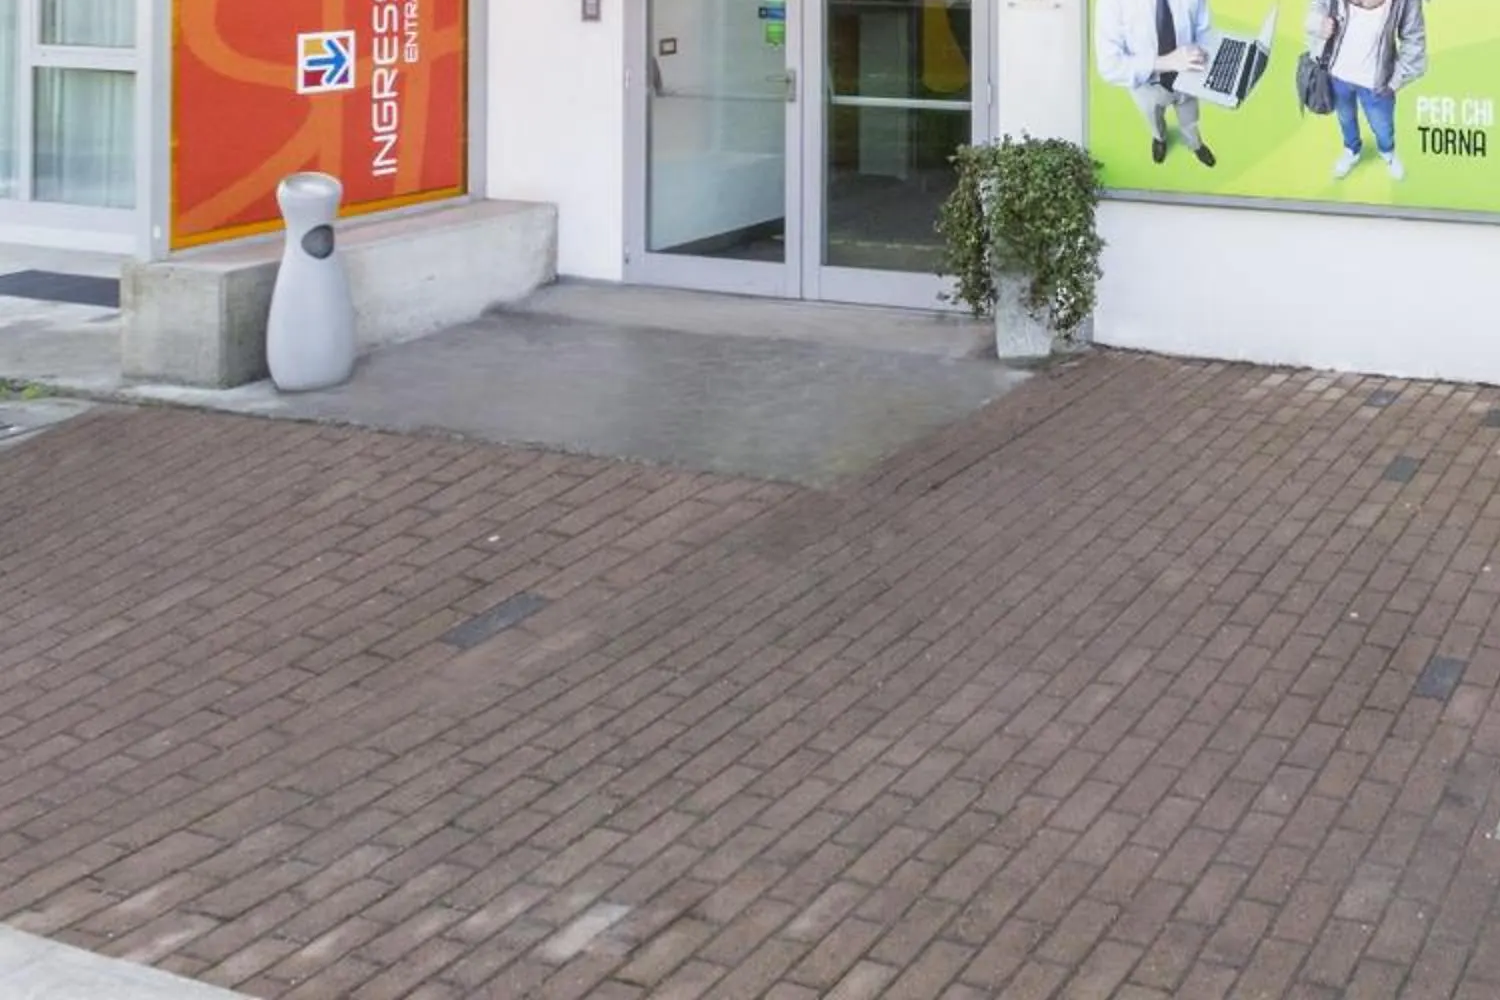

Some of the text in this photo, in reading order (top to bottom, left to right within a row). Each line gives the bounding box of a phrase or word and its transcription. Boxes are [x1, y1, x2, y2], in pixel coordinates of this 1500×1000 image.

[1416, 95, 1494, 127] PER CHI
[1418, 127, 1486, 158] TORNA
